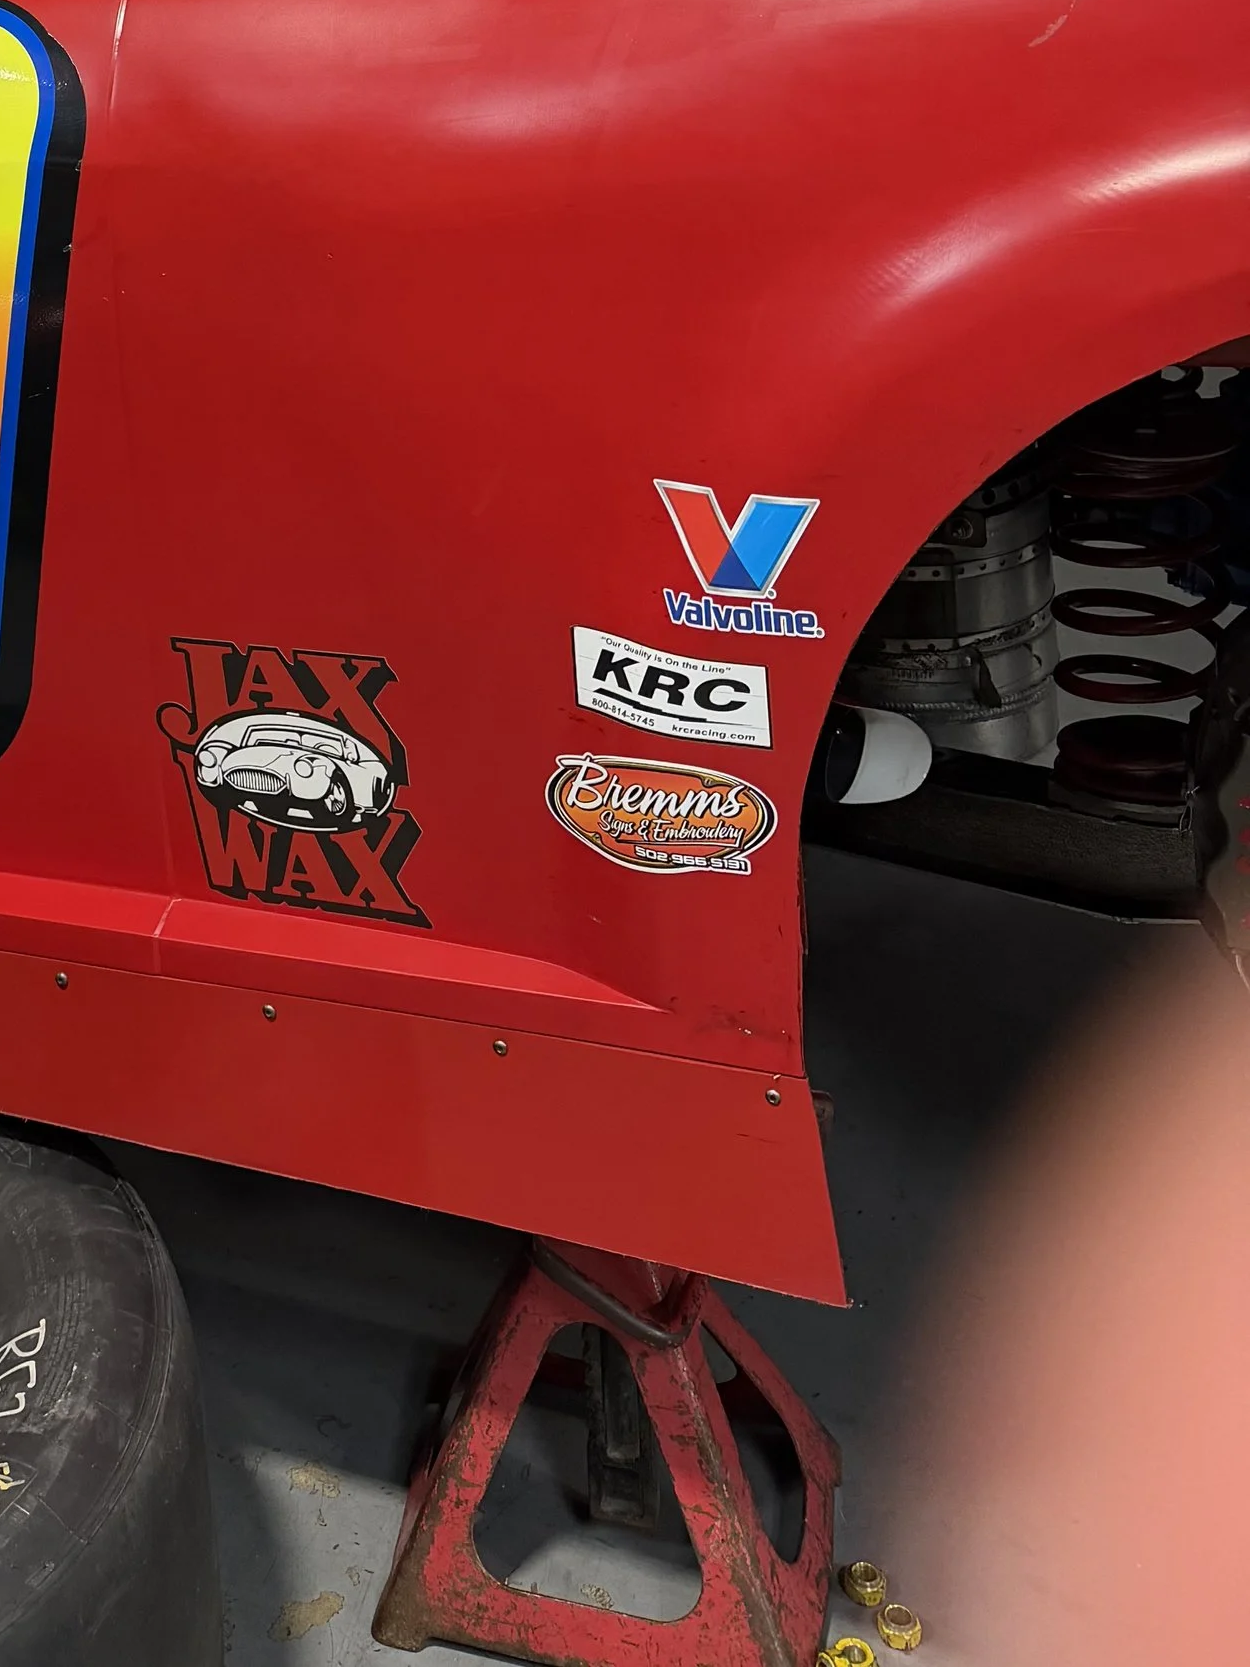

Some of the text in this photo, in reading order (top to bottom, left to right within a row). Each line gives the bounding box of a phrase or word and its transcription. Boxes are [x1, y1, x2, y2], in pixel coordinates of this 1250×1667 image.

[664, 589, 819, 637] Valvoline
[592, 648, 751, 712] KRC
[623, 640, 651, 662] Quality
[665, 656, 680, 667] On
[682, 660, 698, 671] the
[156, 636, 410, 786] JAX
[591, 697, 756, 742] 800-814-5745 krcracing.com
[558, 755, 748, 820] Bremms
[171, 747, 434, 929] WAX
[600, 811, 745, 848] Signs & Embroidery
